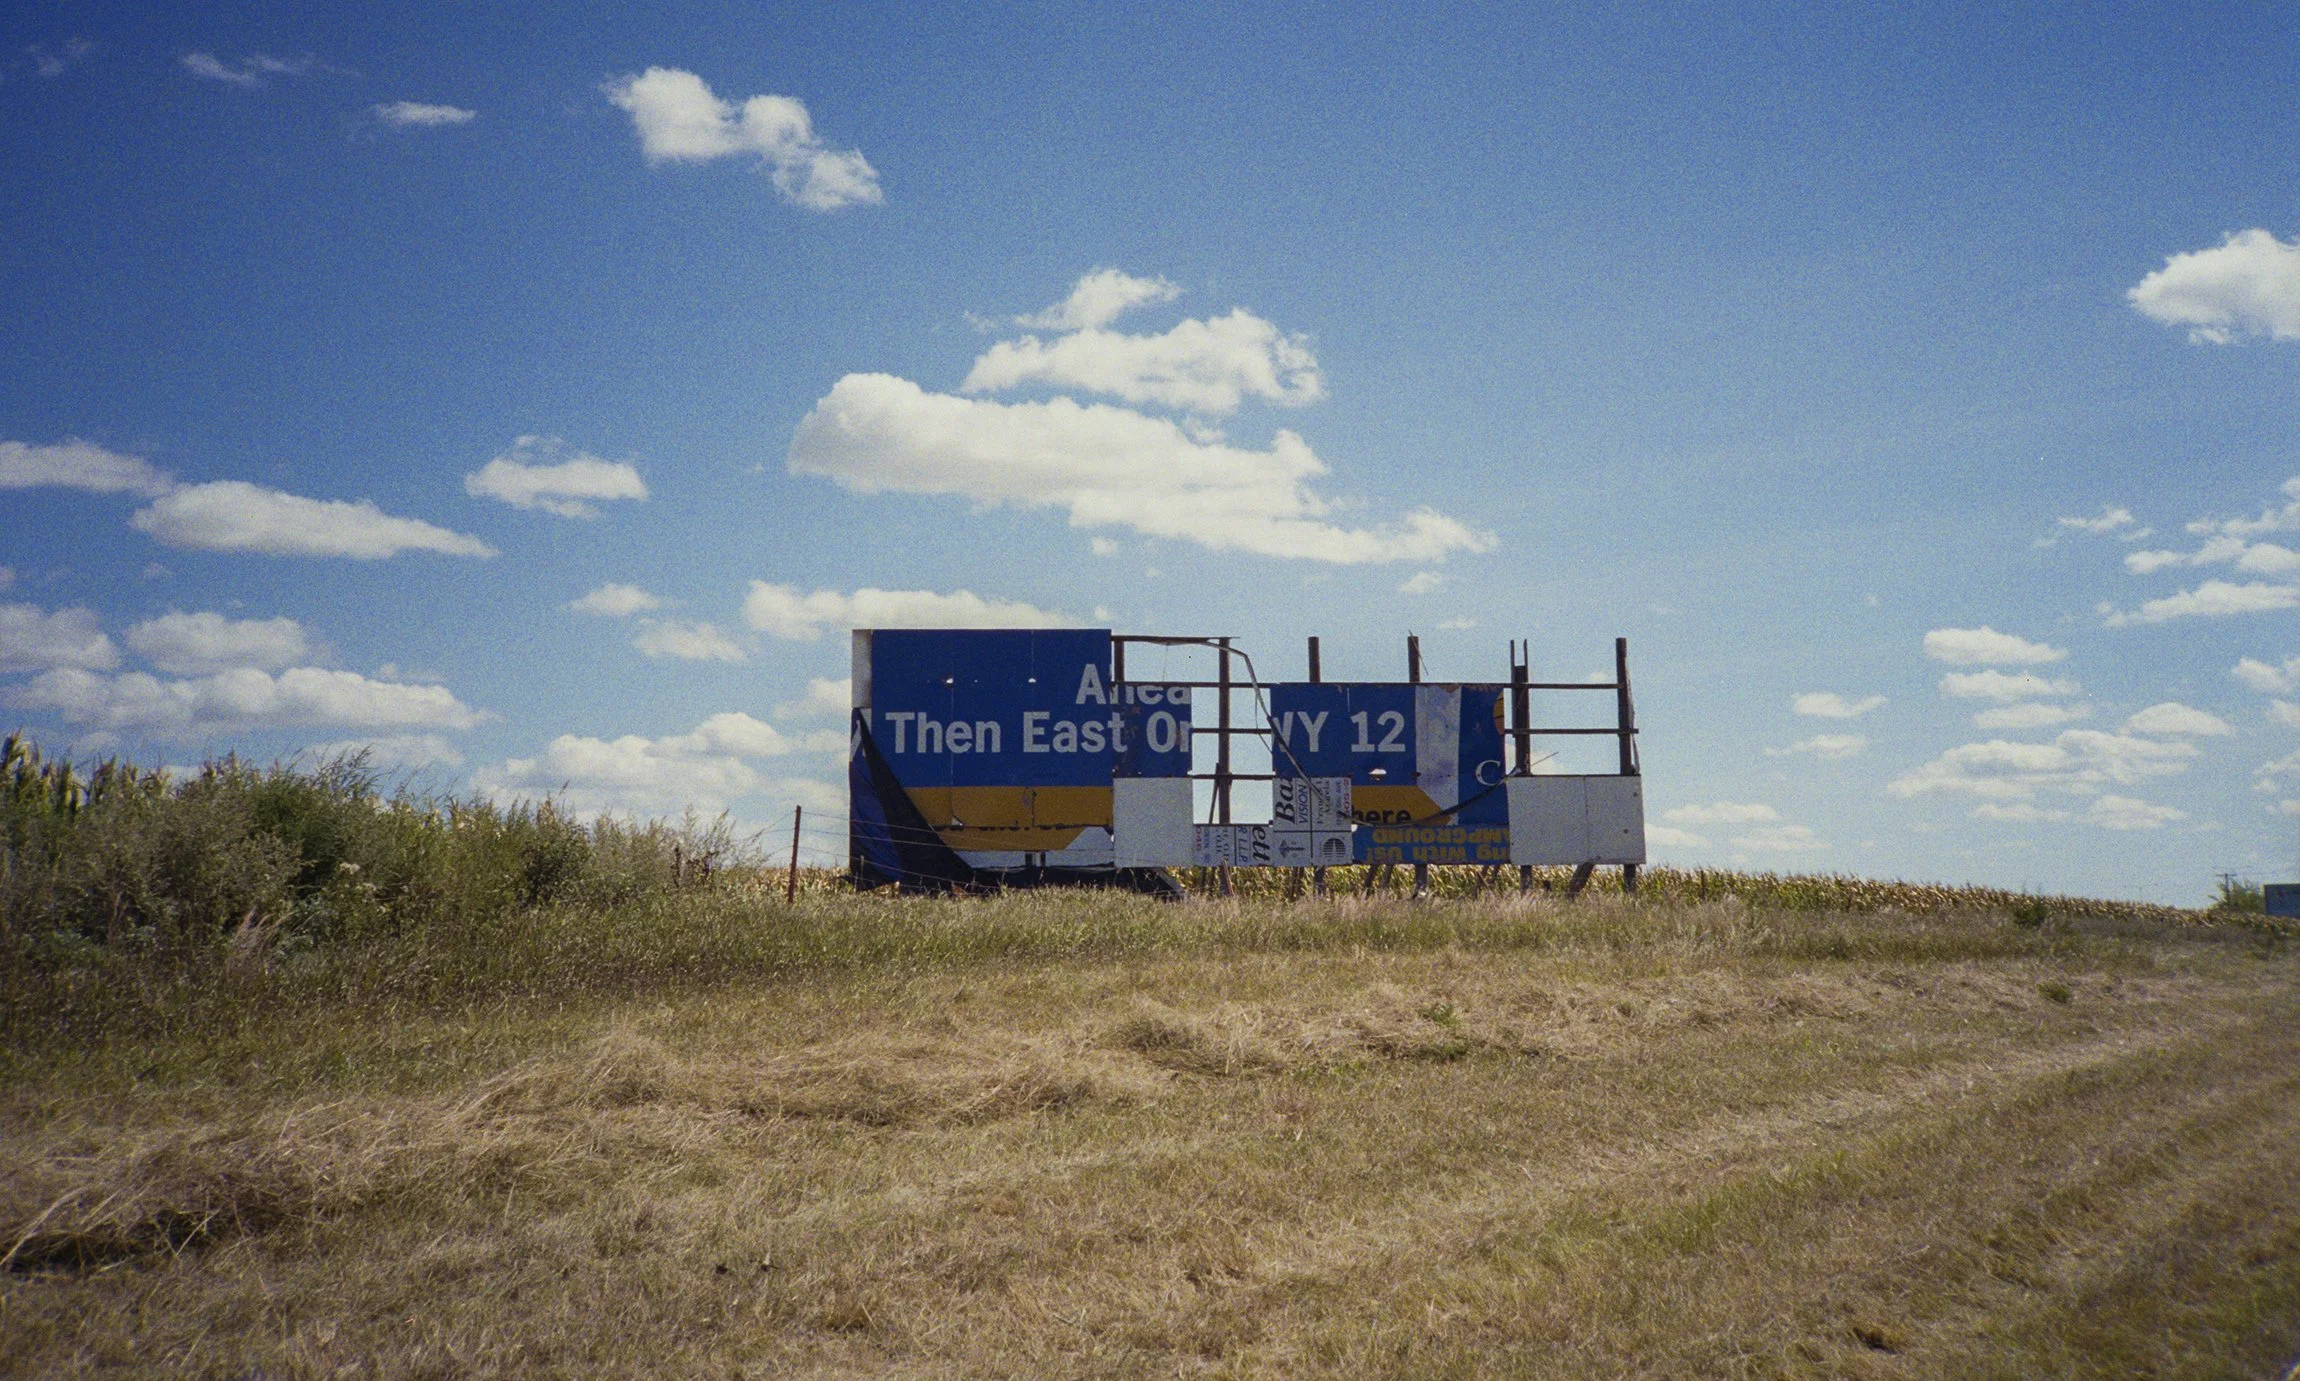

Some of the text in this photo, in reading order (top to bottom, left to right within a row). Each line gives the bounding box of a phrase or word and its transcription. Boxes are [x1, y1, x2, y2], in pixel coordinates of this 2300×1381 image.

[885, 711, 1001, 754] Then
[1023, 711, 1129, 754] East
[1350, 710, 1406, 753] 12
[1297, 784, 1309, 824] VISION
